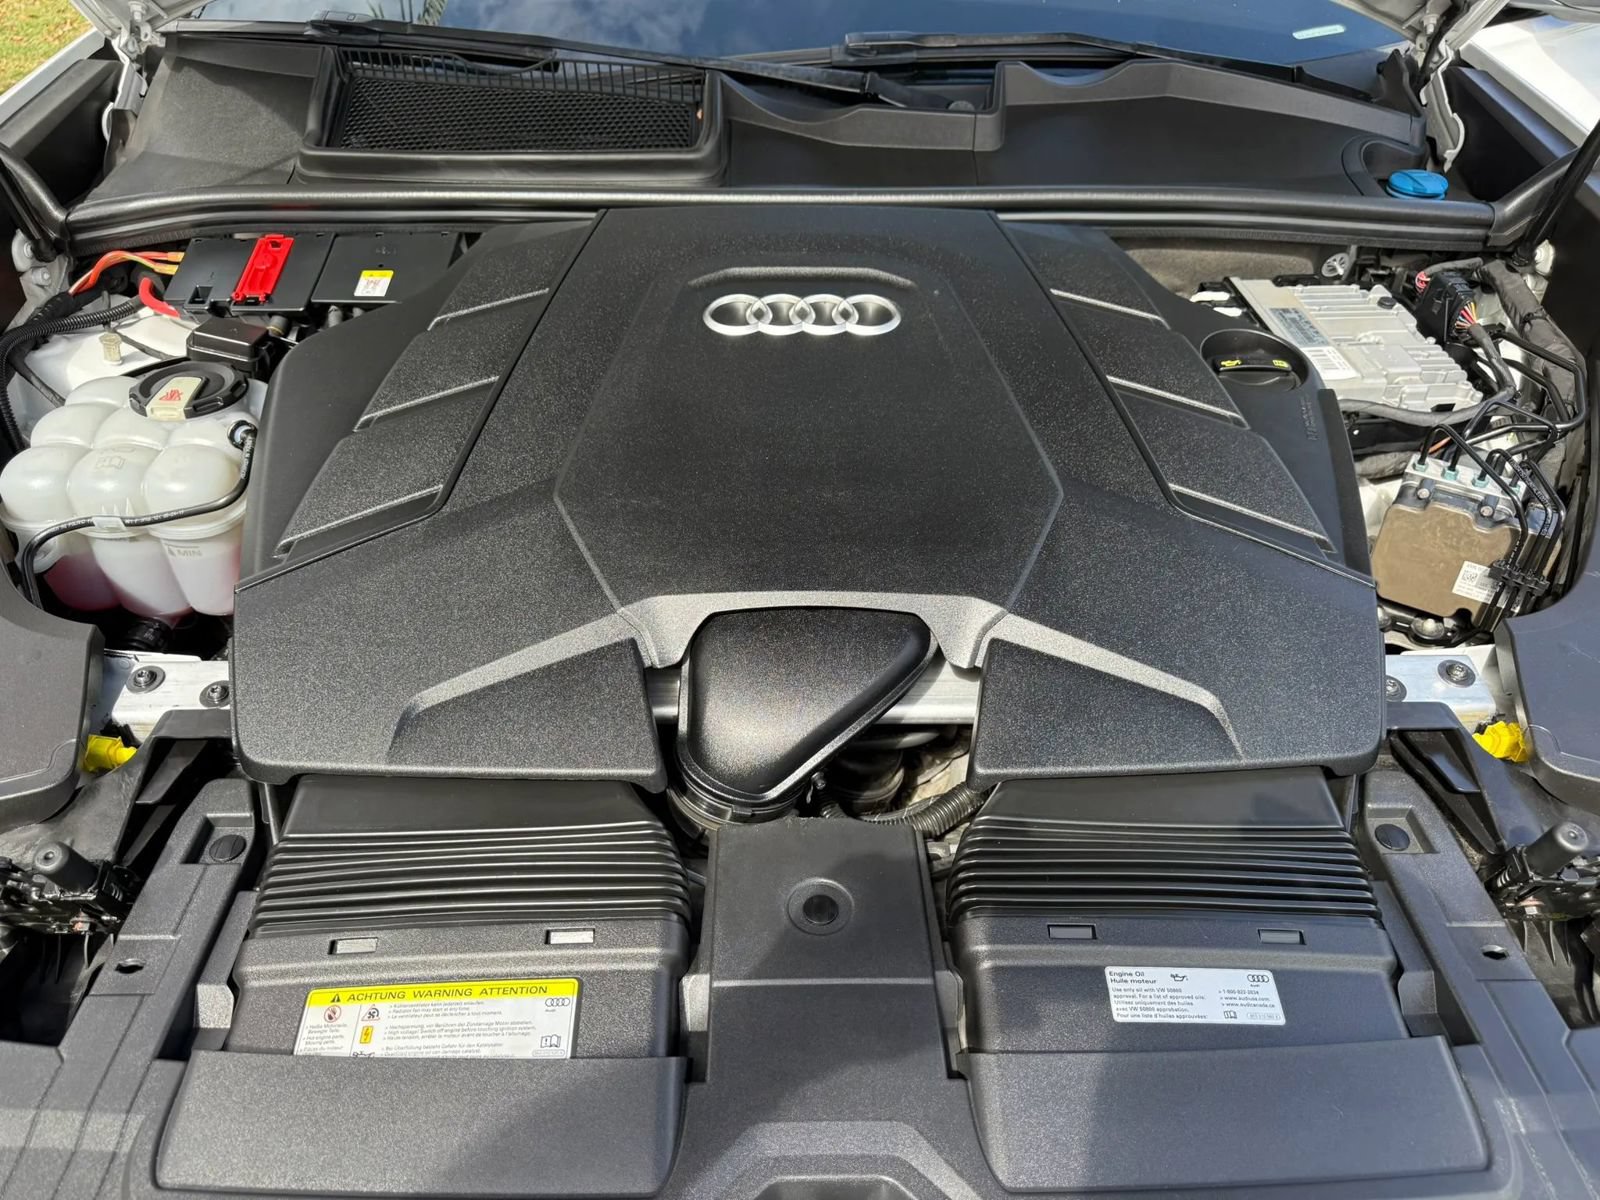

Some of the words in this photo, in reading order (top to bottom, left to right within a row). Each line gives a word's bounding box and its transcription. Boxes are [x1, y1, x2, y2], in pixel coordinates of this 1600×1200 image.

[347, 992, 406, 1002] ACHTUNG
[413, 988, 472, 998] WARNING
[480, 986, 548, 996] ATTENTION
